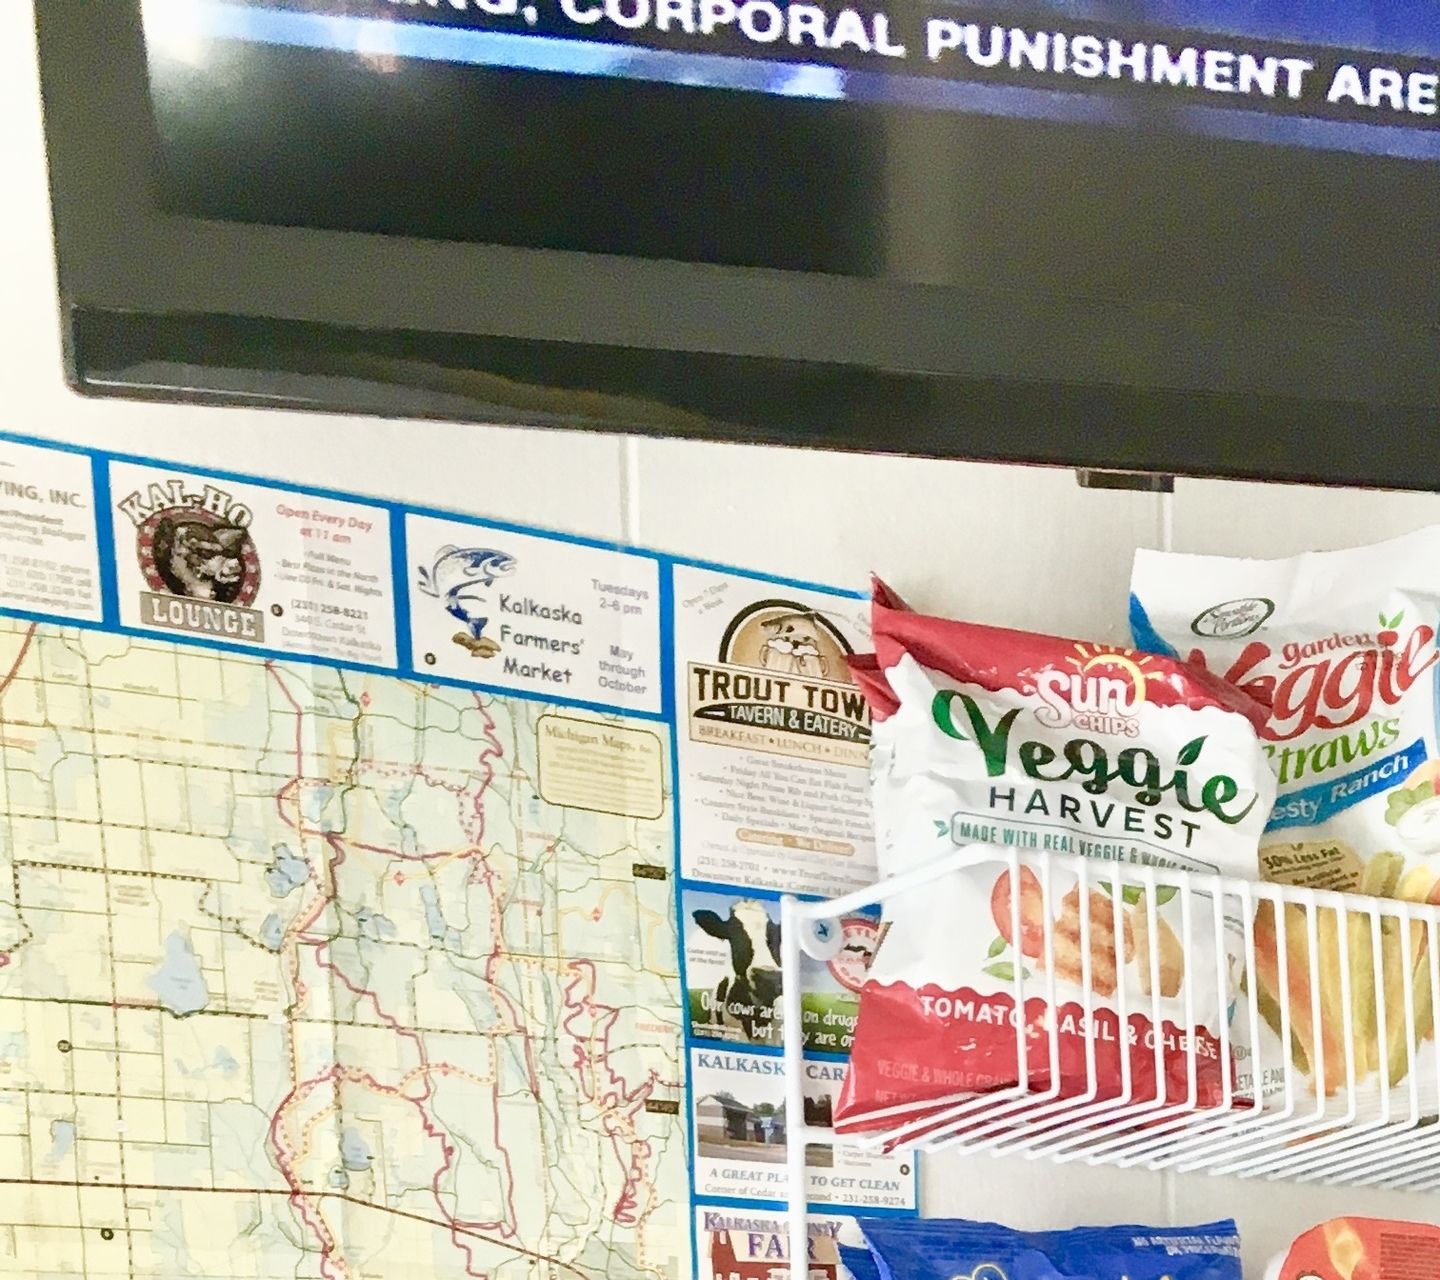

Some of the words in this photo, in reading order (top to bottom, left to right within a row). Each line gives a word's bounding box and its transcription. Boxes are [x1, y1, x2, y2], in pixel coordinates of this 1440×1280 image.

[561, 0, 906, 57] CORPORAL
[926, 18, 1314, 100] PUNISHMENT
[1326, 54, 1437, 116] ARE
[116, 479, 254, 528] KAL-HO
[591, 577, 650, 601] Tuesdays
[150, 597, 258, 639] LOUNGE
[499, 593, 583, 625] Kalkaska
[499, 624, 585, 656] Farmers'
[1279, 631, 1375, 671] garden
[503, 655, 573, 684] Market
[598, 660, 646, 680] through
[692, 667, 791, 704] TROUT
[803, 684, 868, 723] TOW
[1034, 669, 1144, 729] Sun
[727, 704, 785, 729] TAVERN
[788, 709, 801, 730] &
[803, 713, 860, 741] EATERY
[1073, 711, 1141, 739] CHIPS
[698, 724, 768, 746] BREAKFAST
[776, 736, 824, 755] LUNCH
[931, 688, 1259, 825] Veggie
[1330, 753, 1410, 805] Ranch
[988, 786, 1202, 849] HARVEST
[959, 820, 998, 846] MADE
[1002, 824, 1038, 850] WITH
[1041, 828, 1075, 855] REAL
[1078, 838, 1126, 863] VEGGIE
[700, 991, 723, 1014] Our
[728, 1001, 756, 1019] cows
[802, 1012, 819, 1025] on
[751, 1020, 774, 1040] but
[815, 1029, 837, 1047] are
[721, 1168, 763, 1183] GREAT
[809, 1174, 829, 1187] TO
[830, 1176, 855, 1190] GET
[858, 1177, 900, 1192] CLEAN
